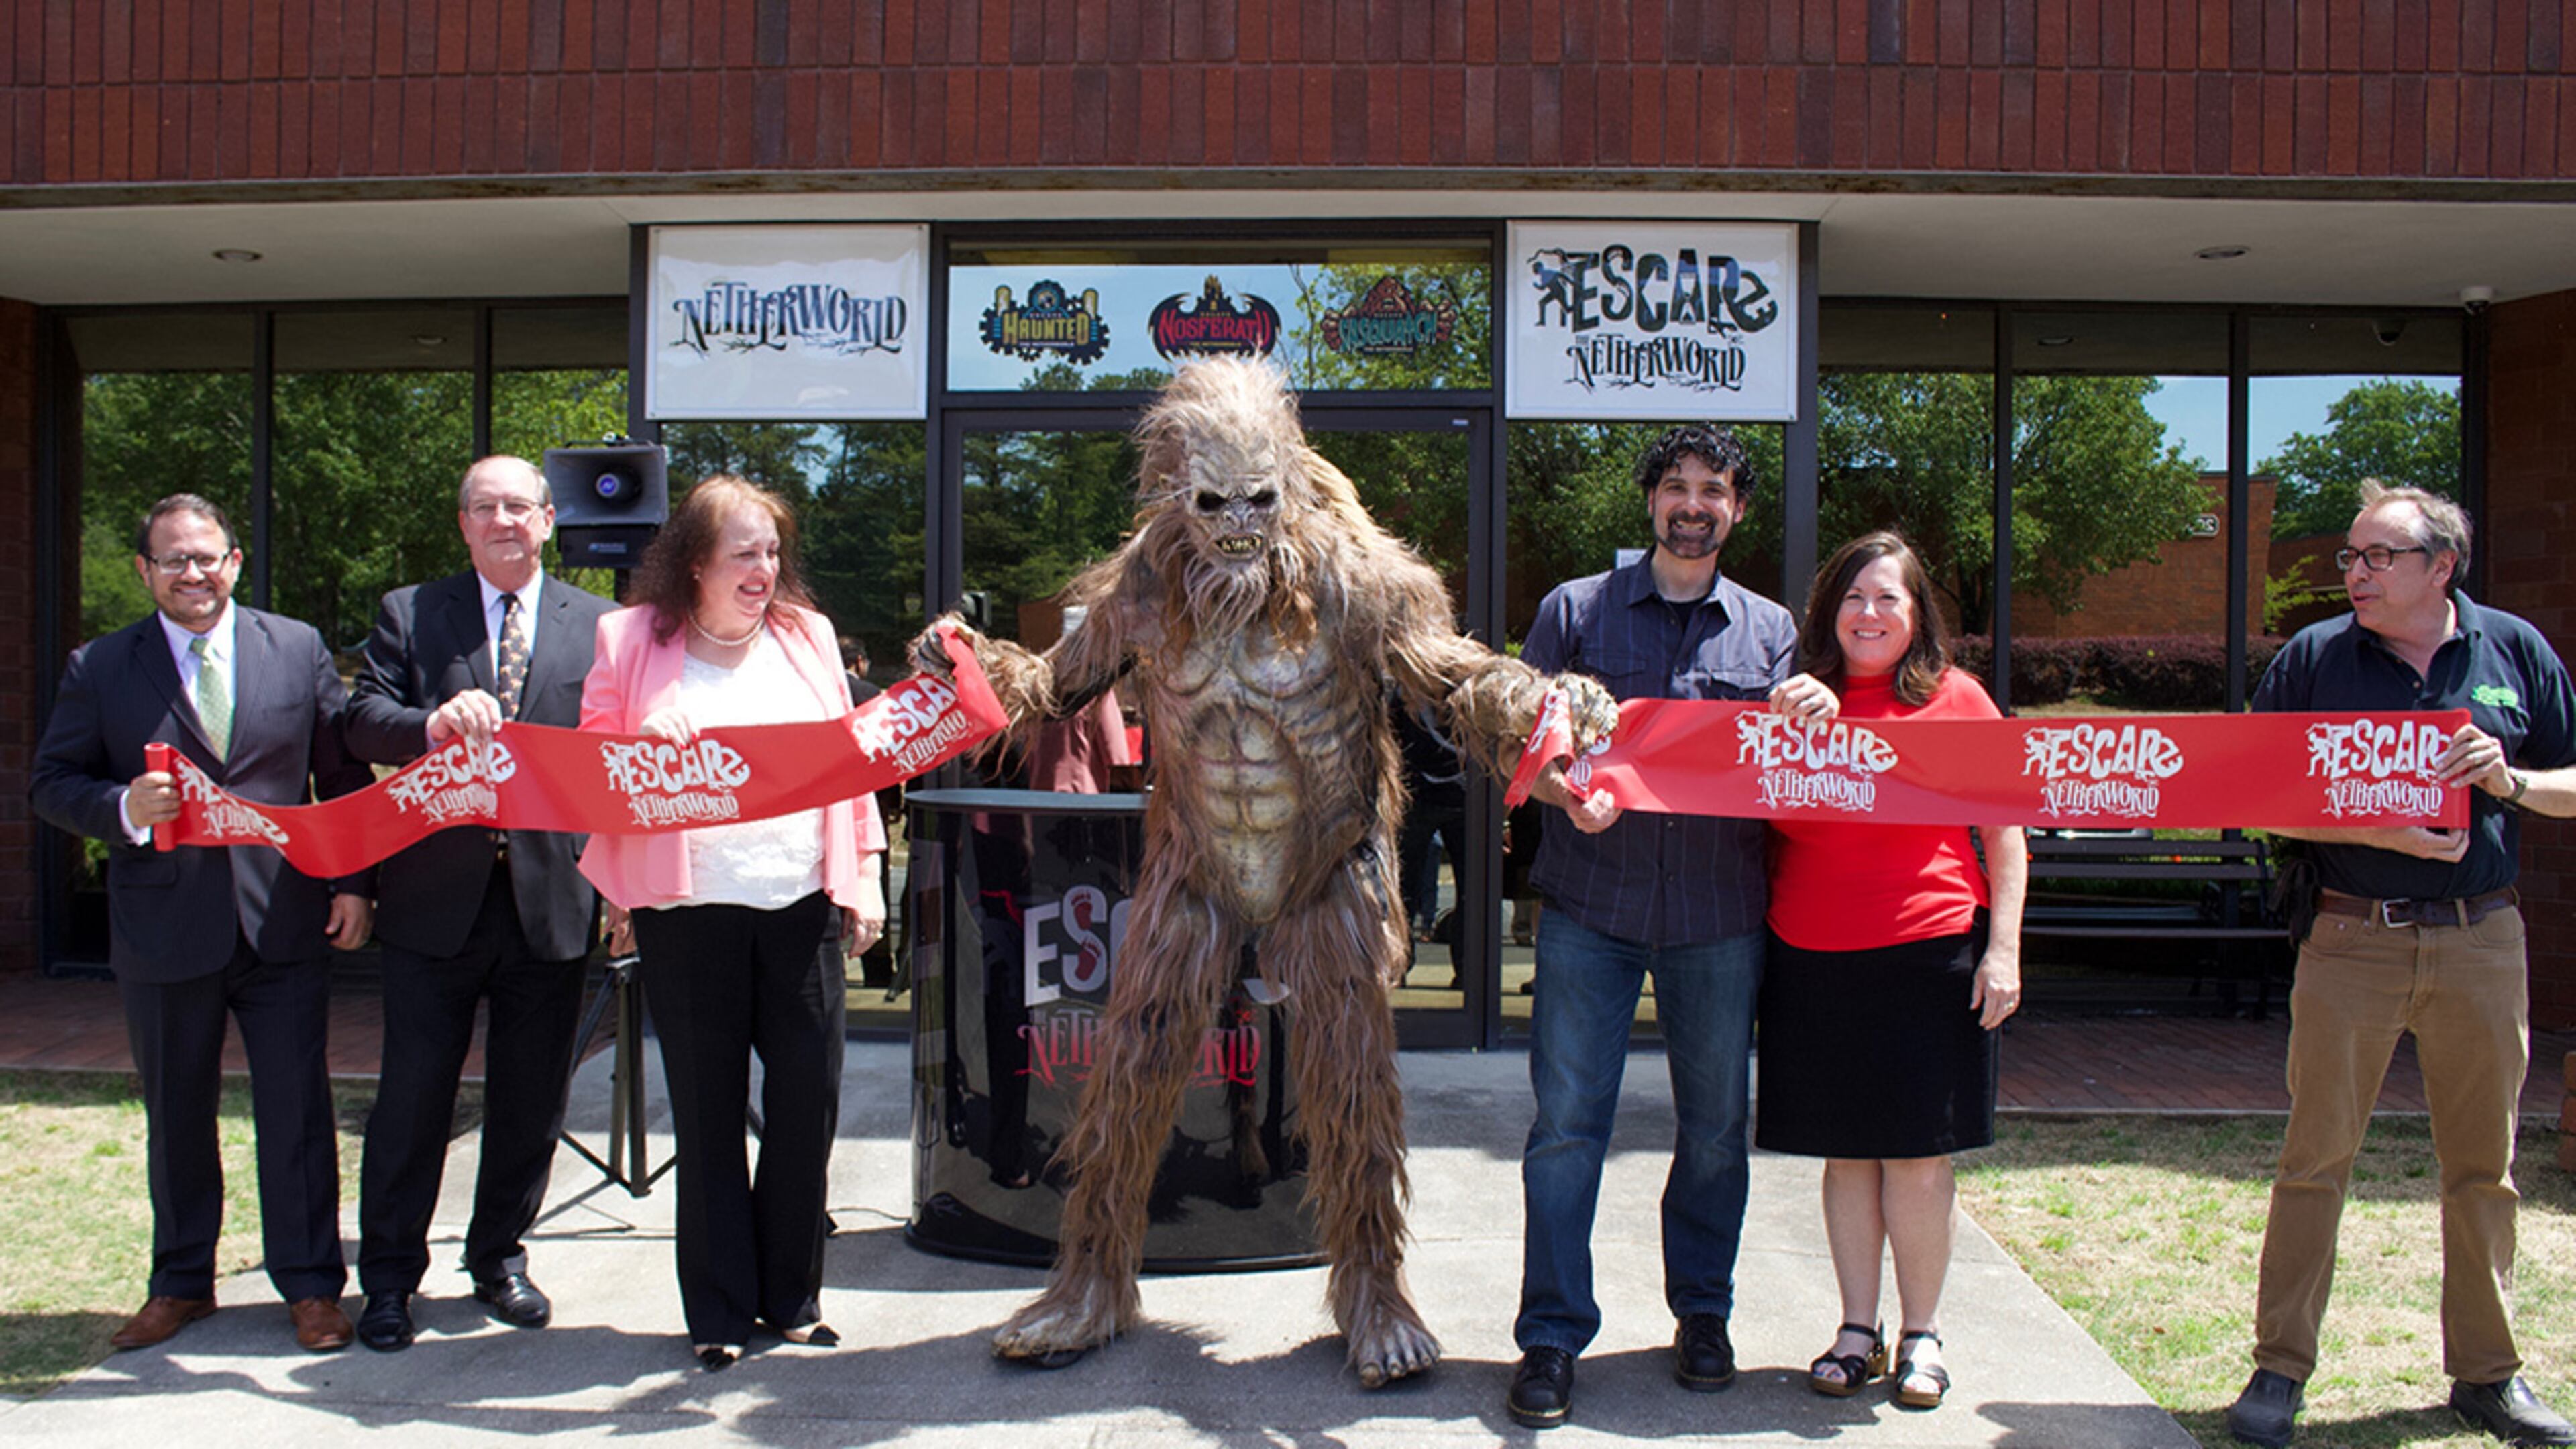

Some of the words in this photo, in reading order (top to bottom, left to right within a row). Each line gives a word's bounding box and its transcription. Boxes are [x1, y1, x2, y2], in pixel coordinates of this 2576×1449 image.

[671, 282, 908, 356] NETHERWORLD
[1002, 311, 1089, 346] HAUNTED
[1565, 334, 1746, 391] NETHERWORLD
